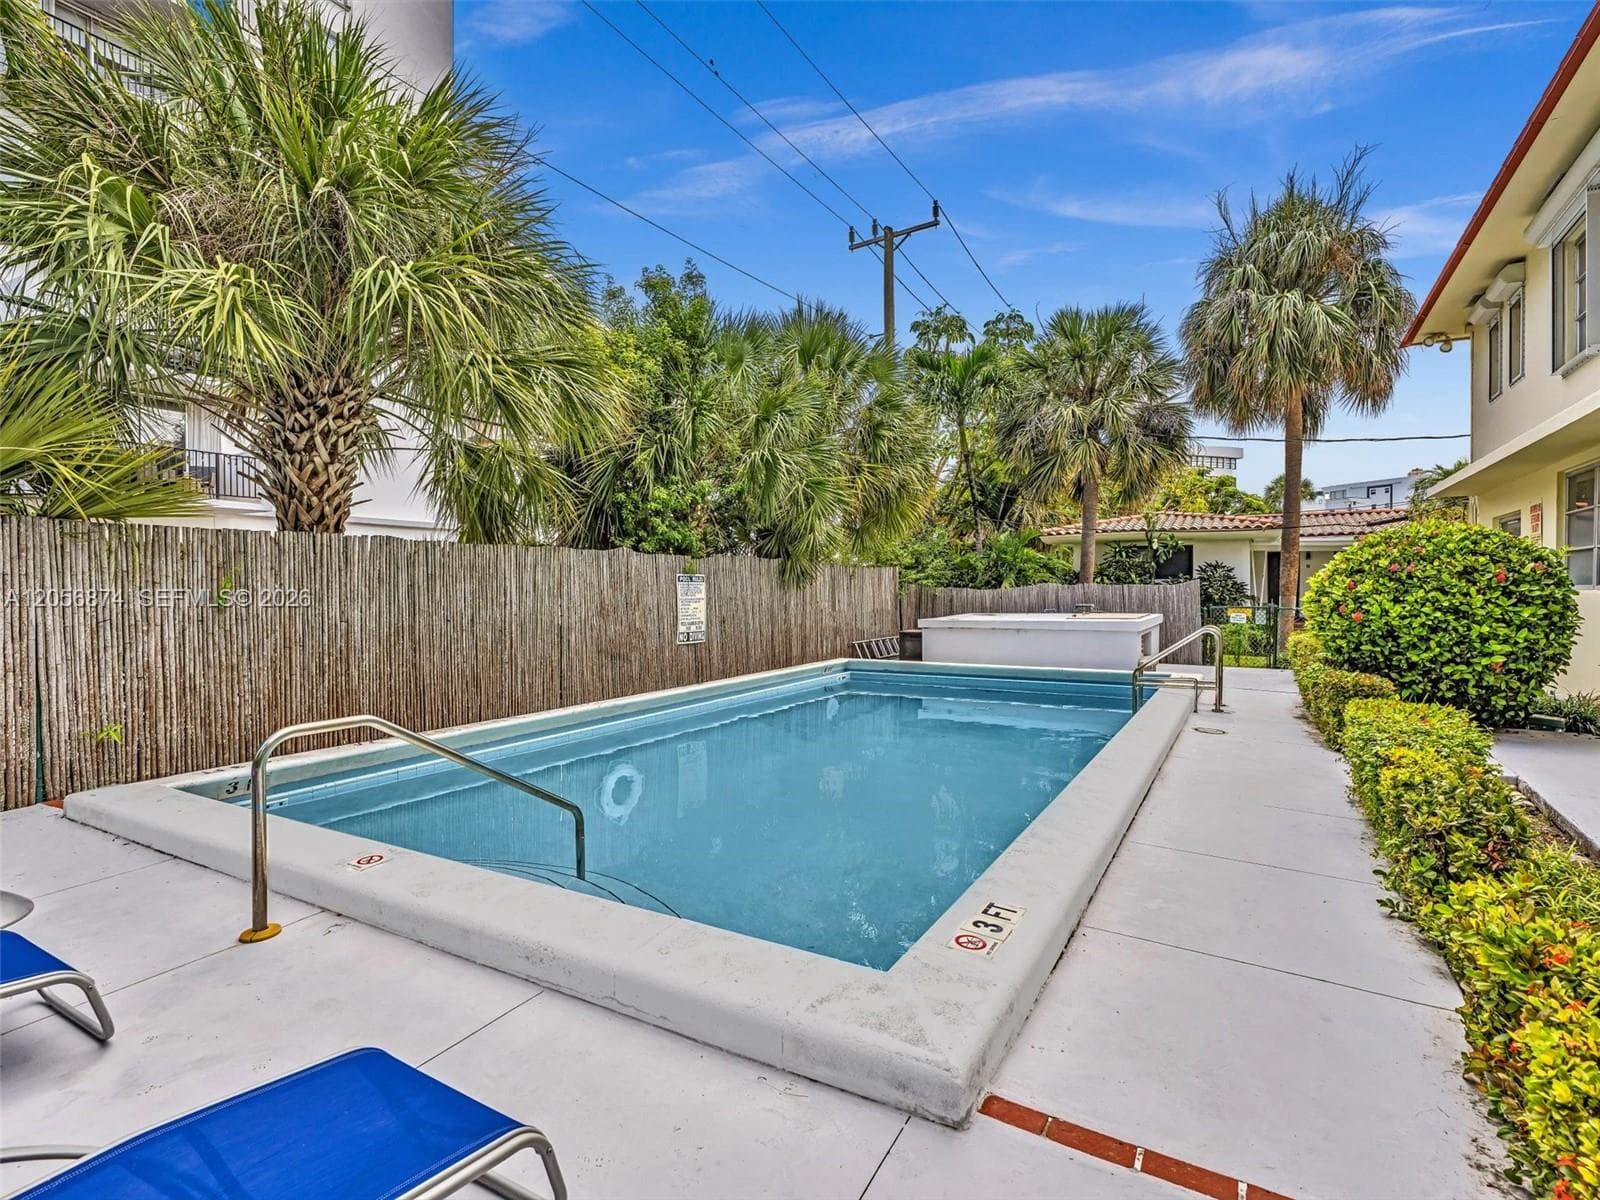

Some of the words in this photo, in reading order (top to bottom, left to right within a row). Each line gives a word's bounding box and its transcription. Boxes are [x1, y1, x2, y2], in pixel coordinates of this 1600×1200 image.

[679, 632, 688, 641] NO
[981, 902, 1018, 921] FT
[972, 920, 1004, 933] 3
